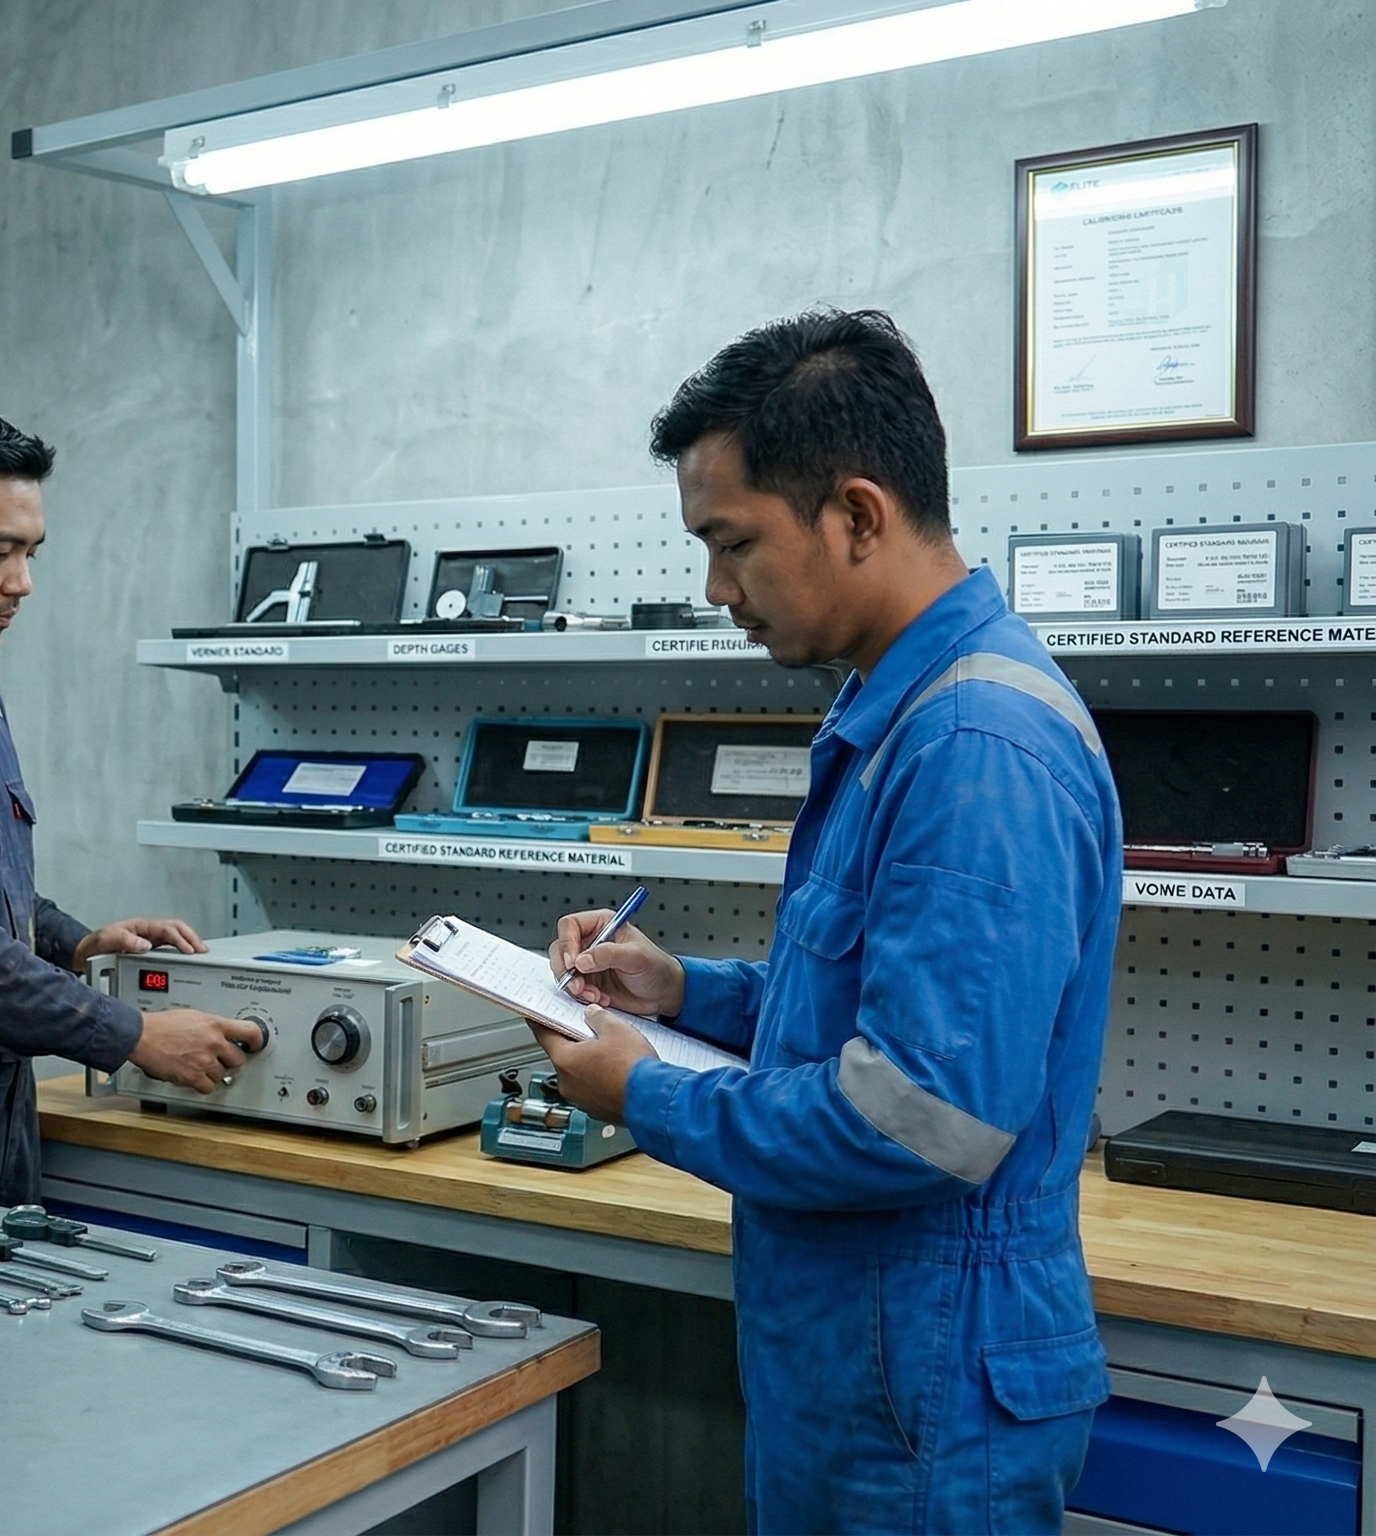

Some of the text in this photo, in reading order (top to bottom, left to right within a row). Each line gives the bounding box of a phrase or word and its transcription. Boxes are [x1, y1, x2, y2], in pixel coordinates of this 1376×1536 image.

[1046, 633, 1125, 646] CERTIFIED
[1129, 631, 1216, 645] STANDARD
[1221, 628, 1323, 643] REFERENCE
[393, 643, 469, 655] DEPTH GAGES
[1191, 886, 1236, 901] DATA
